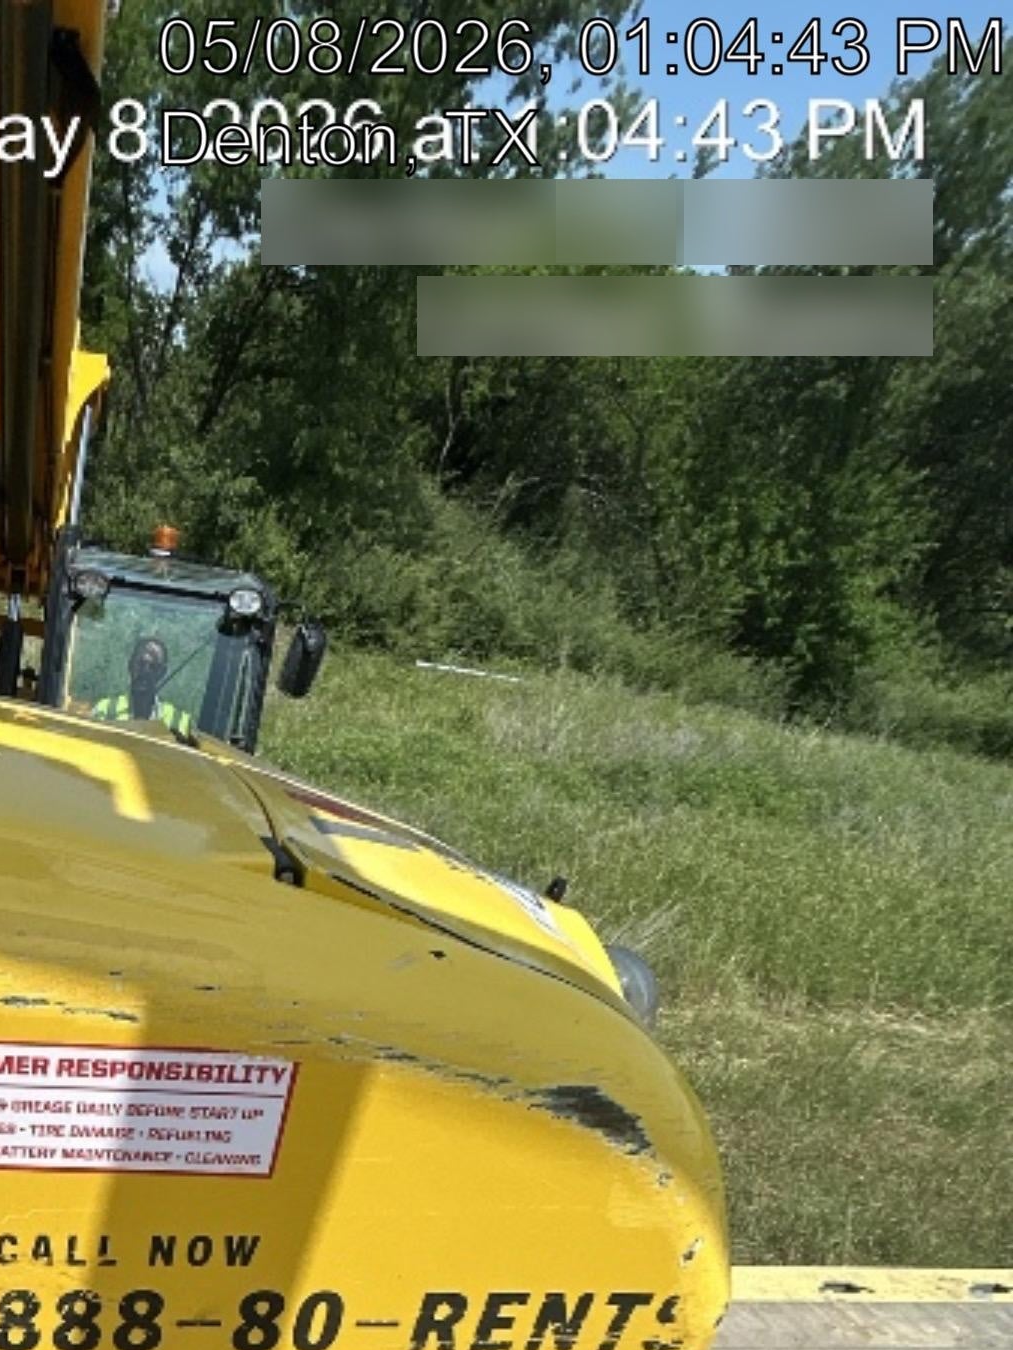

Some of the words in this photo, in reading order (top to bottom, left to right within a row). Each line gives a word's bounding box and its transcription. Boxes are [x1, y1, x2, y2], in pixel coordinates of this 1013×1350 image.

[56, 1059, 288, 1085] RESPONSIBILITY
[10, 1100, 72, 1115] GREASE
[76, 1102, 123, 1117] DAILY
[124, 1104, 187, 1119] BEFORE
[189, 1106, 236, 1121] START
[30, 1124, 66, 1138] TIRE
[69, 1125, 136, 1141] DAMAGE
[61, 1148, 174, 1165] MAINTENANCE
[184, 1152, 262, 1167] CLEANING
[148, 1235, 261, 1268] NOW
